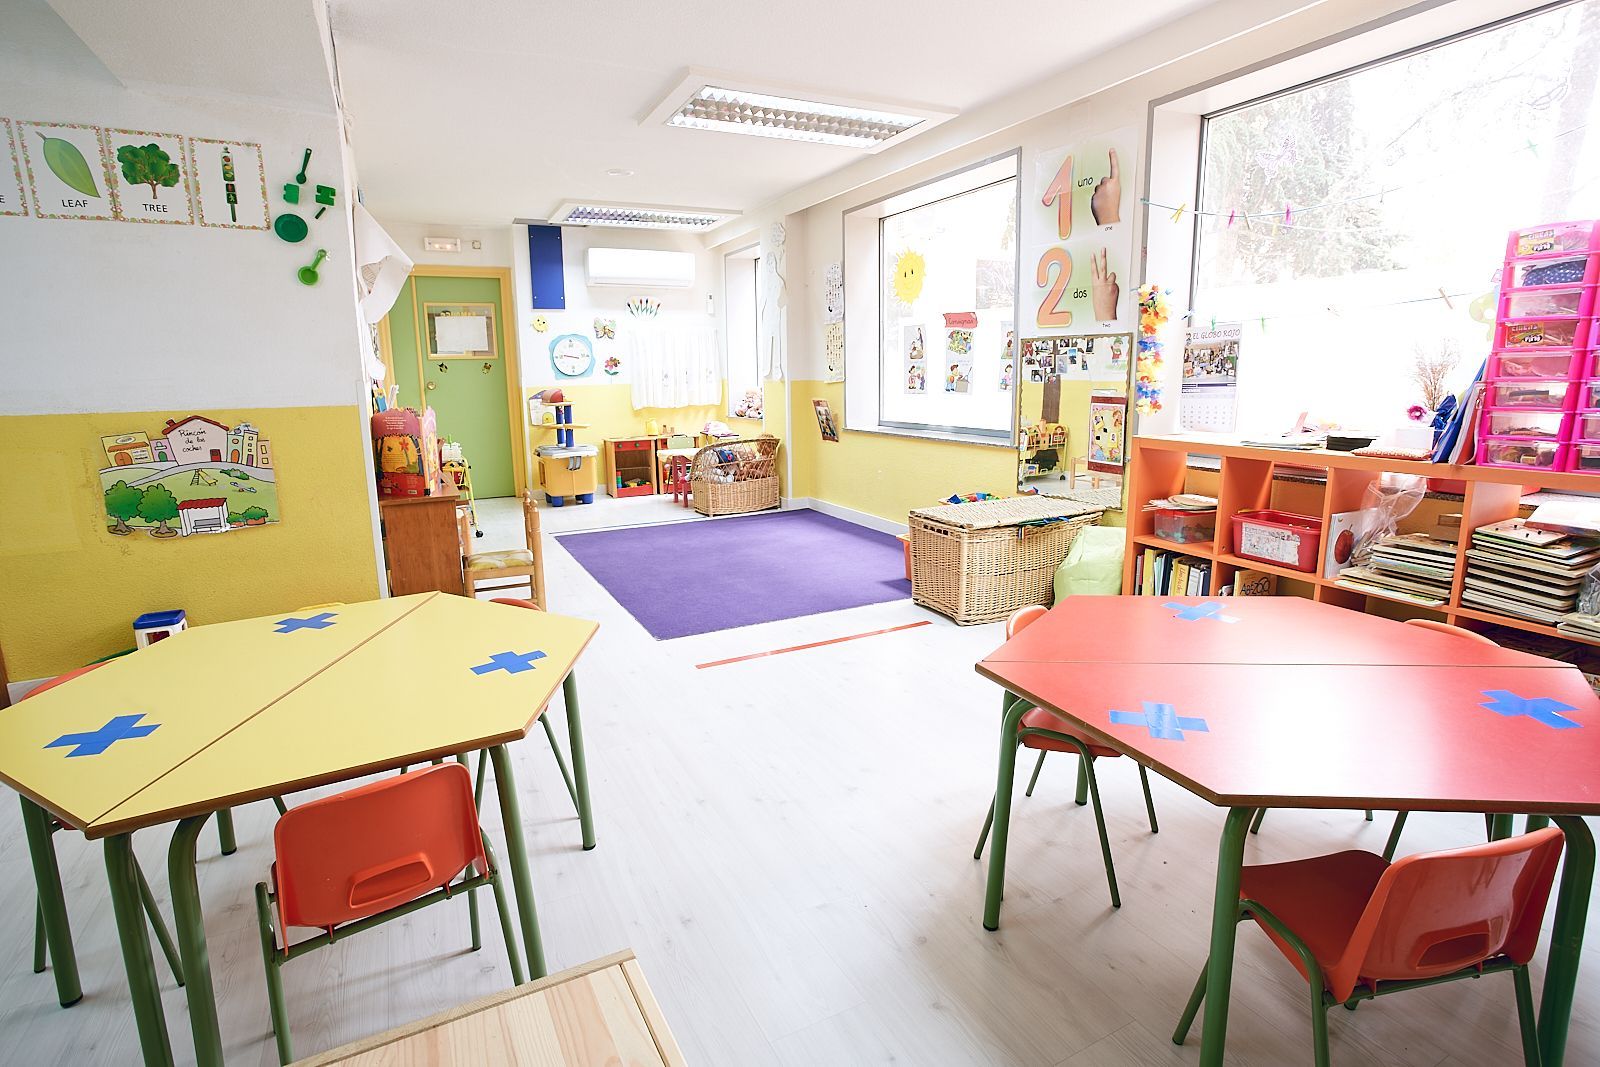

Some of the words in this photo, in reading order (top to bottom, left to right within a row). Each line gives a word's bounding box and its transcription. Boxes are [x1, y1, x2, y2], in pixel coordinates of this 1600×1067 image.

[1077, 177, 1094, 187] uno
[1042, 155, 1072, 240] 1
[61, 199, 89, 208] LEAF
[142, 203, 168, 213] TREE
[1036, 247, 1073, 328] 2
[1073, 288, 1088, 299] dos
[1192, 332, 1200, 340] EL
[1201, 330, 1222, 339] GLOBO
[1223, 328, 1241, 338] ROJO
[184, 437, 193, 445] de
